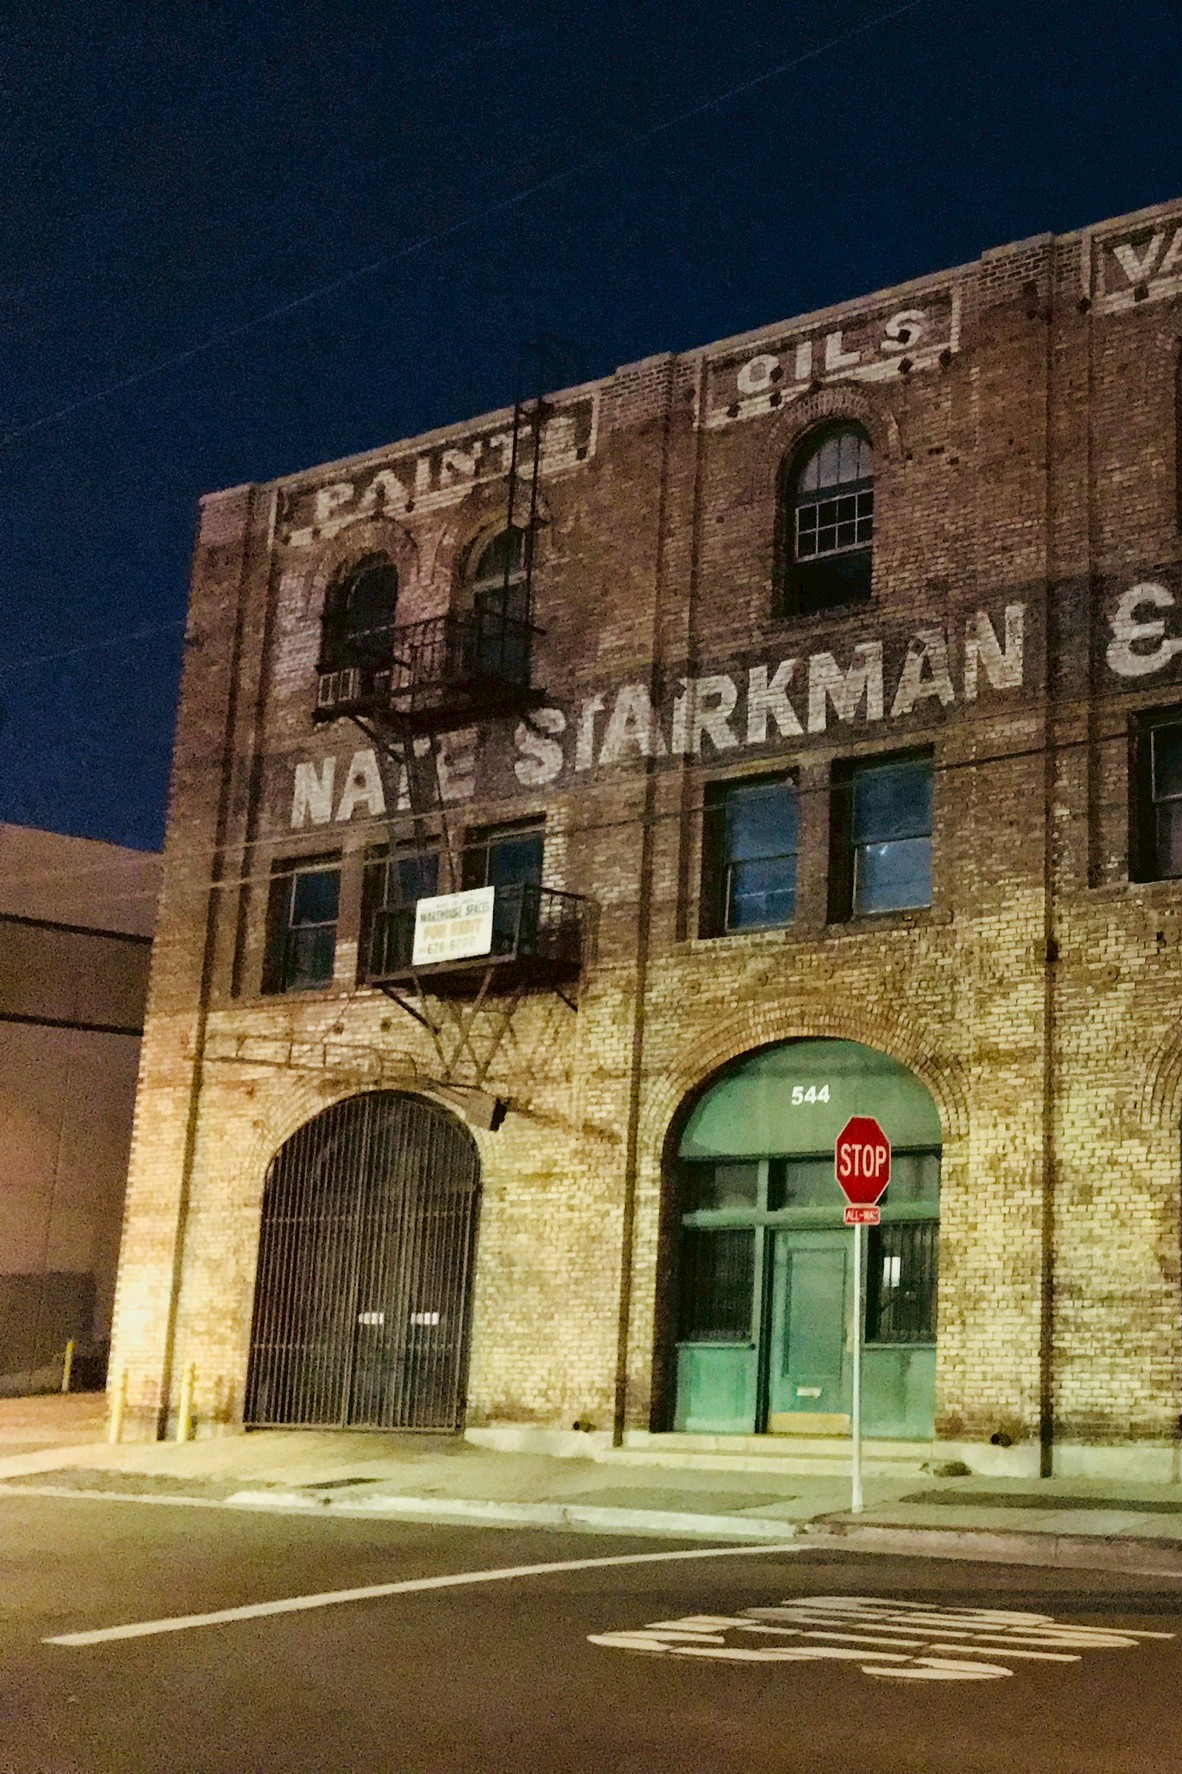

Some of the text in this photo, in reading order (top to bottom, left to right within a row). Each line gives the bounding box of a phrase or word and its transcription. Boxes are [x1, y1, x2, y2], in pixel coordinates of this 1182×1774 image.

[737, 309, 926, 395] OILS
[514, 602, 1026, 786] STARKMAN
[791, 1084, 830, 1106] 544
[839, 1143, 886, 1177] STOP
[586, 1596, 1176, 1680] STOP
